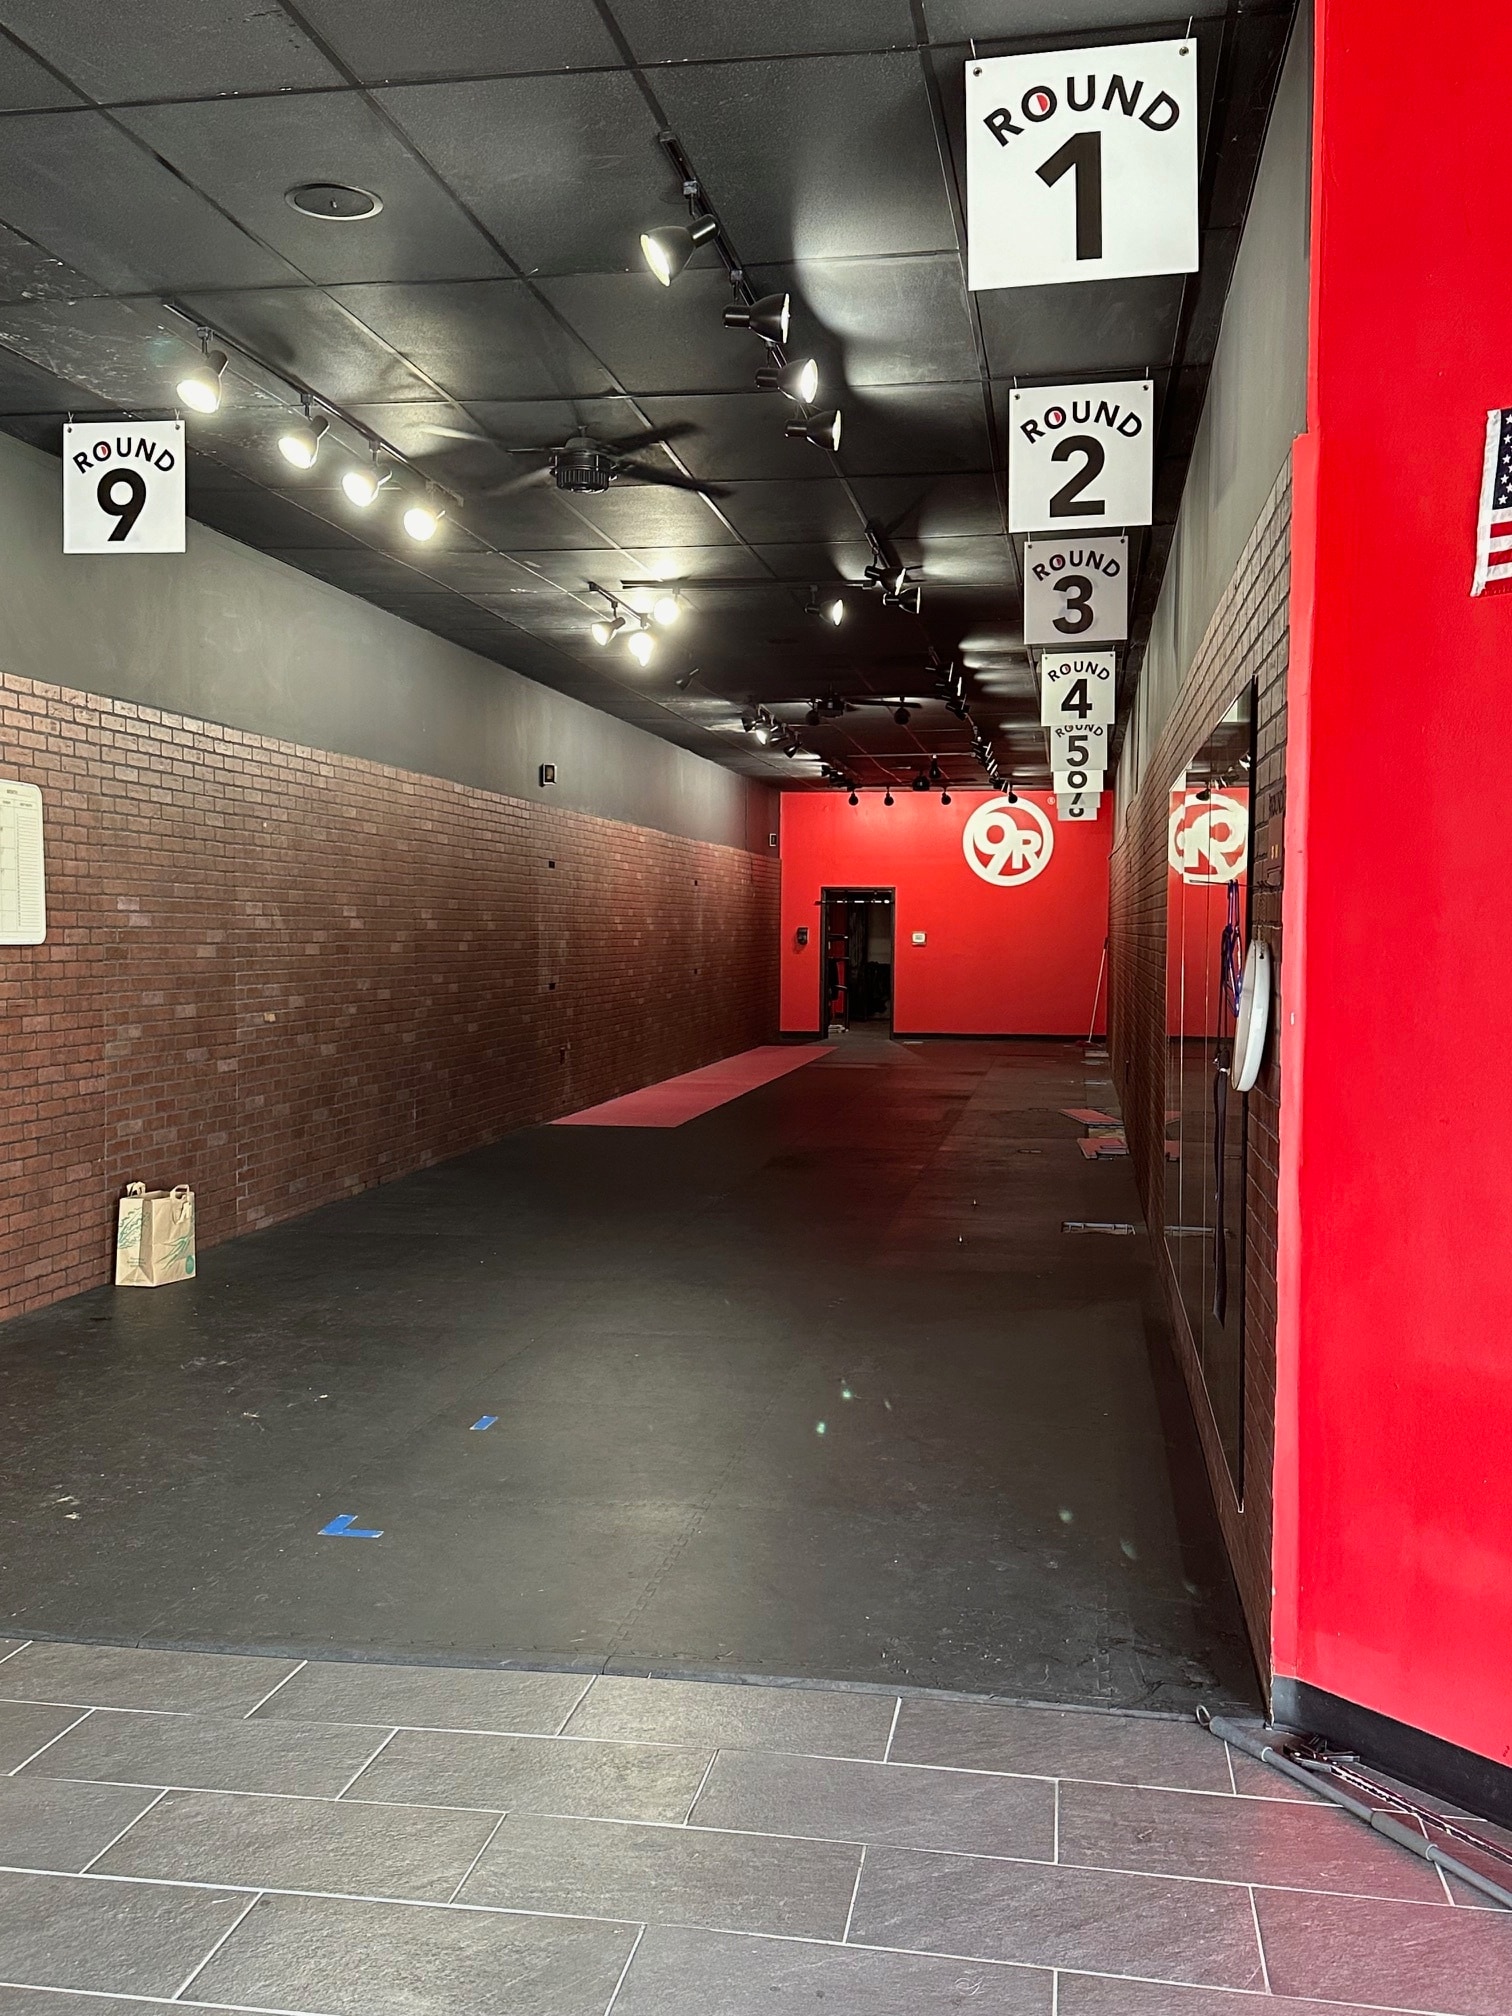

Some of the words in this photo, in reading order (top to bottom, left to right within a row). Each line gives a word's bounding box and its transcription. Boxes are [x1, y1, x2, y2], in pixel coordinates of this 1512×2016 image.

[983, 74, 1180, 147] ROUND
[1035, 131, 1102, 261] 1
[1020, 400, 1142, 444] ROUND
[73, 437, 175, 474] ROUND
[1049, 434, 1105, 518] 2
[97, 467, 147, 542] 9
[1032, 550, 1121, 581] ROUND
[1052, 574, 1094, 634] 3
[1047, 661, 1110, 682] ROUND
[1060, 678, 1093, 719] 4
[1066, 734, 1089, 767] 5
[972, 811, 1043, 876] 9R
